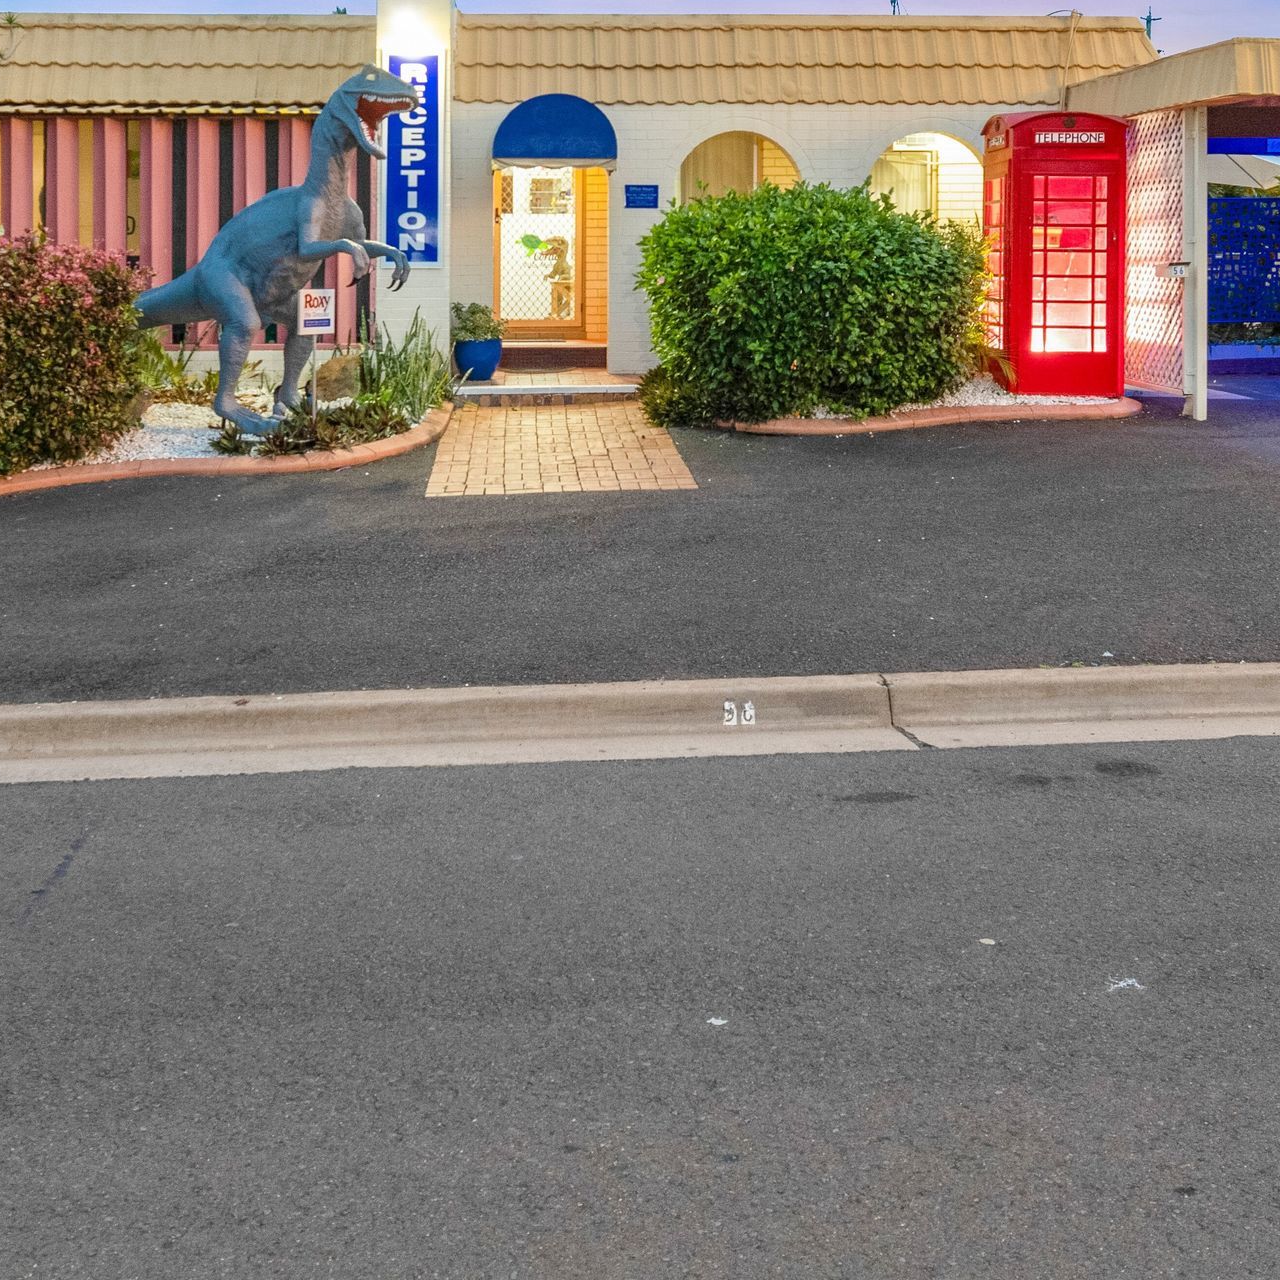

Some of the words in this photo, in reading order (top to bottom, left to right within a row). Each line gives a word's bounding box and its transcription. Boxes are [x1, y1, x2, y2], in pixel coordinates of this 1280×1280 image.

[1036, 132, 1105, 143] TELEPHONE
[1173, 266, 1184, 275] 56
[304, 293, 331, 312] Roxy
